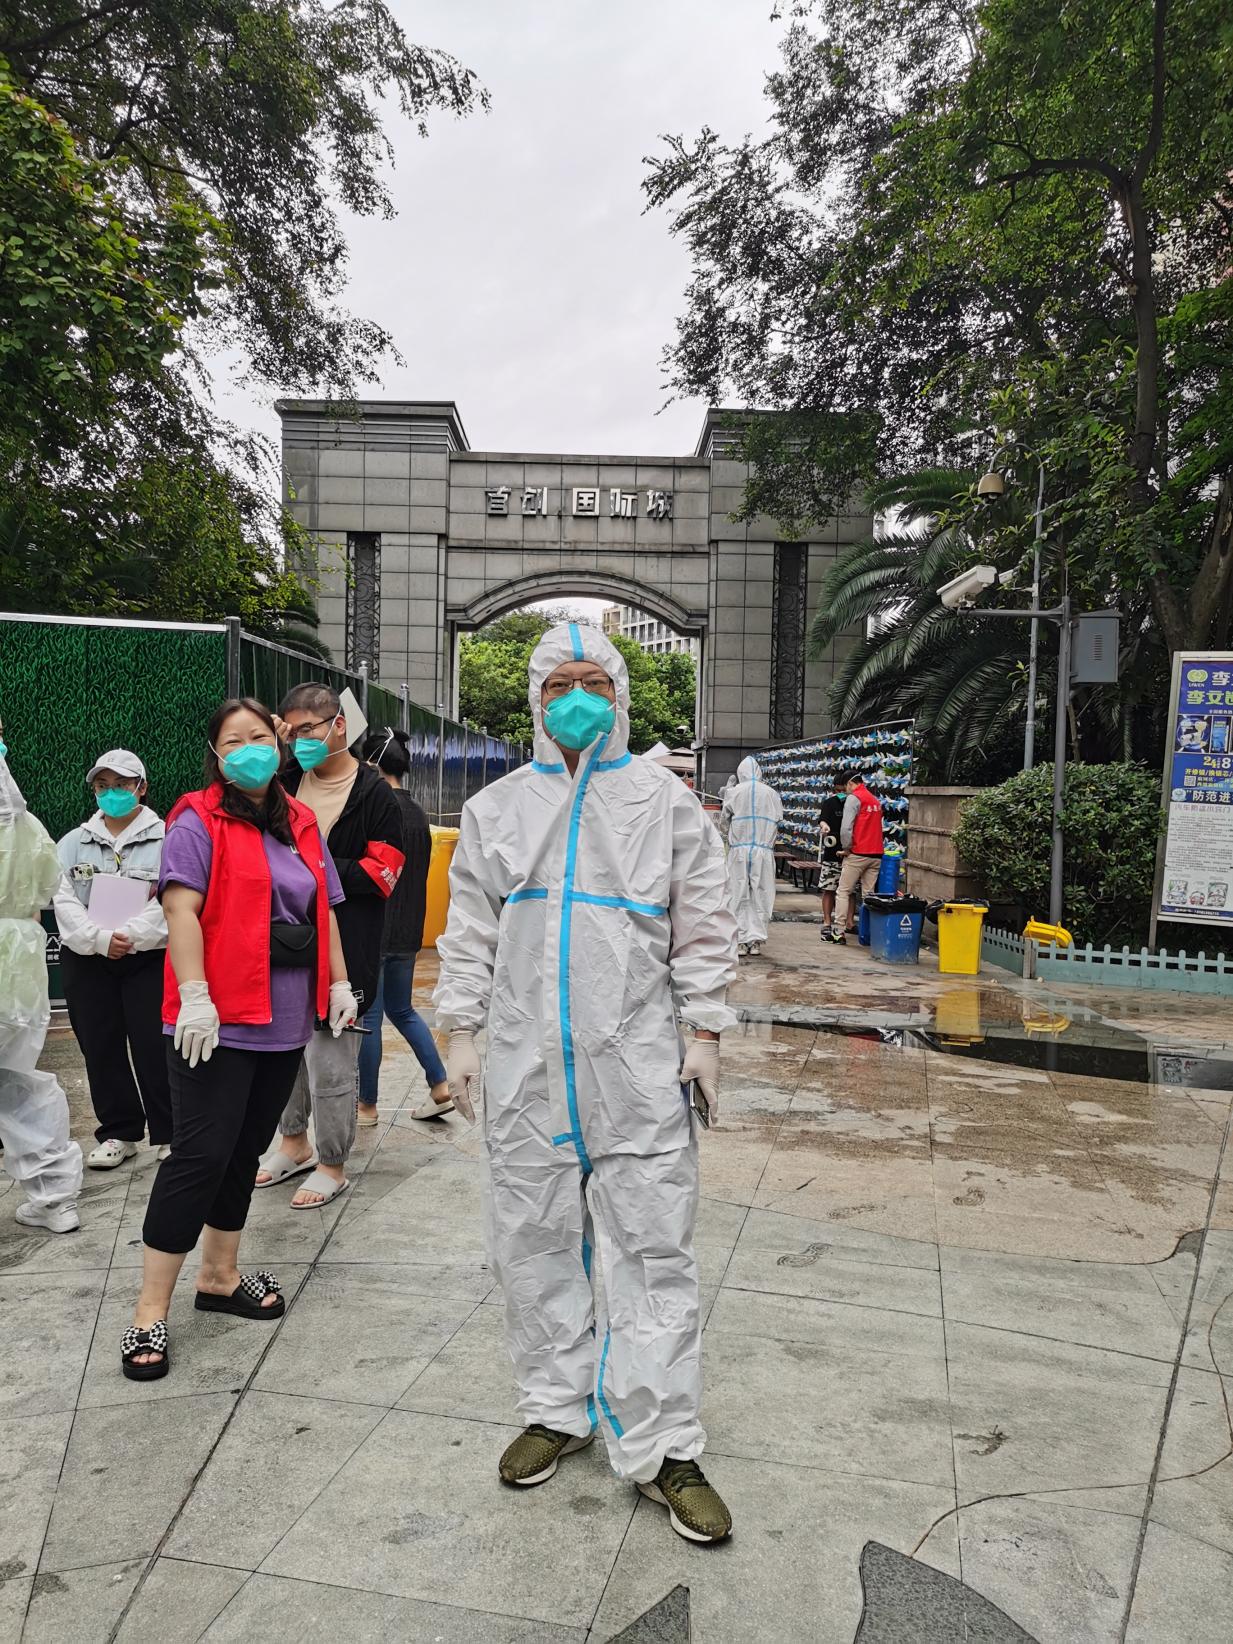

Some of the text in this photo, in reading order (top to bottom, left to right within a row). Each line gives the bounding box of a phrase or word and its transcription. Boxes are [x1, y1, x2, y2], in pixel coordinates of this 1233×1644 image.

[485, 486, 673, 520] 首创国际城
[1212, 671, 1233, 686] 李
